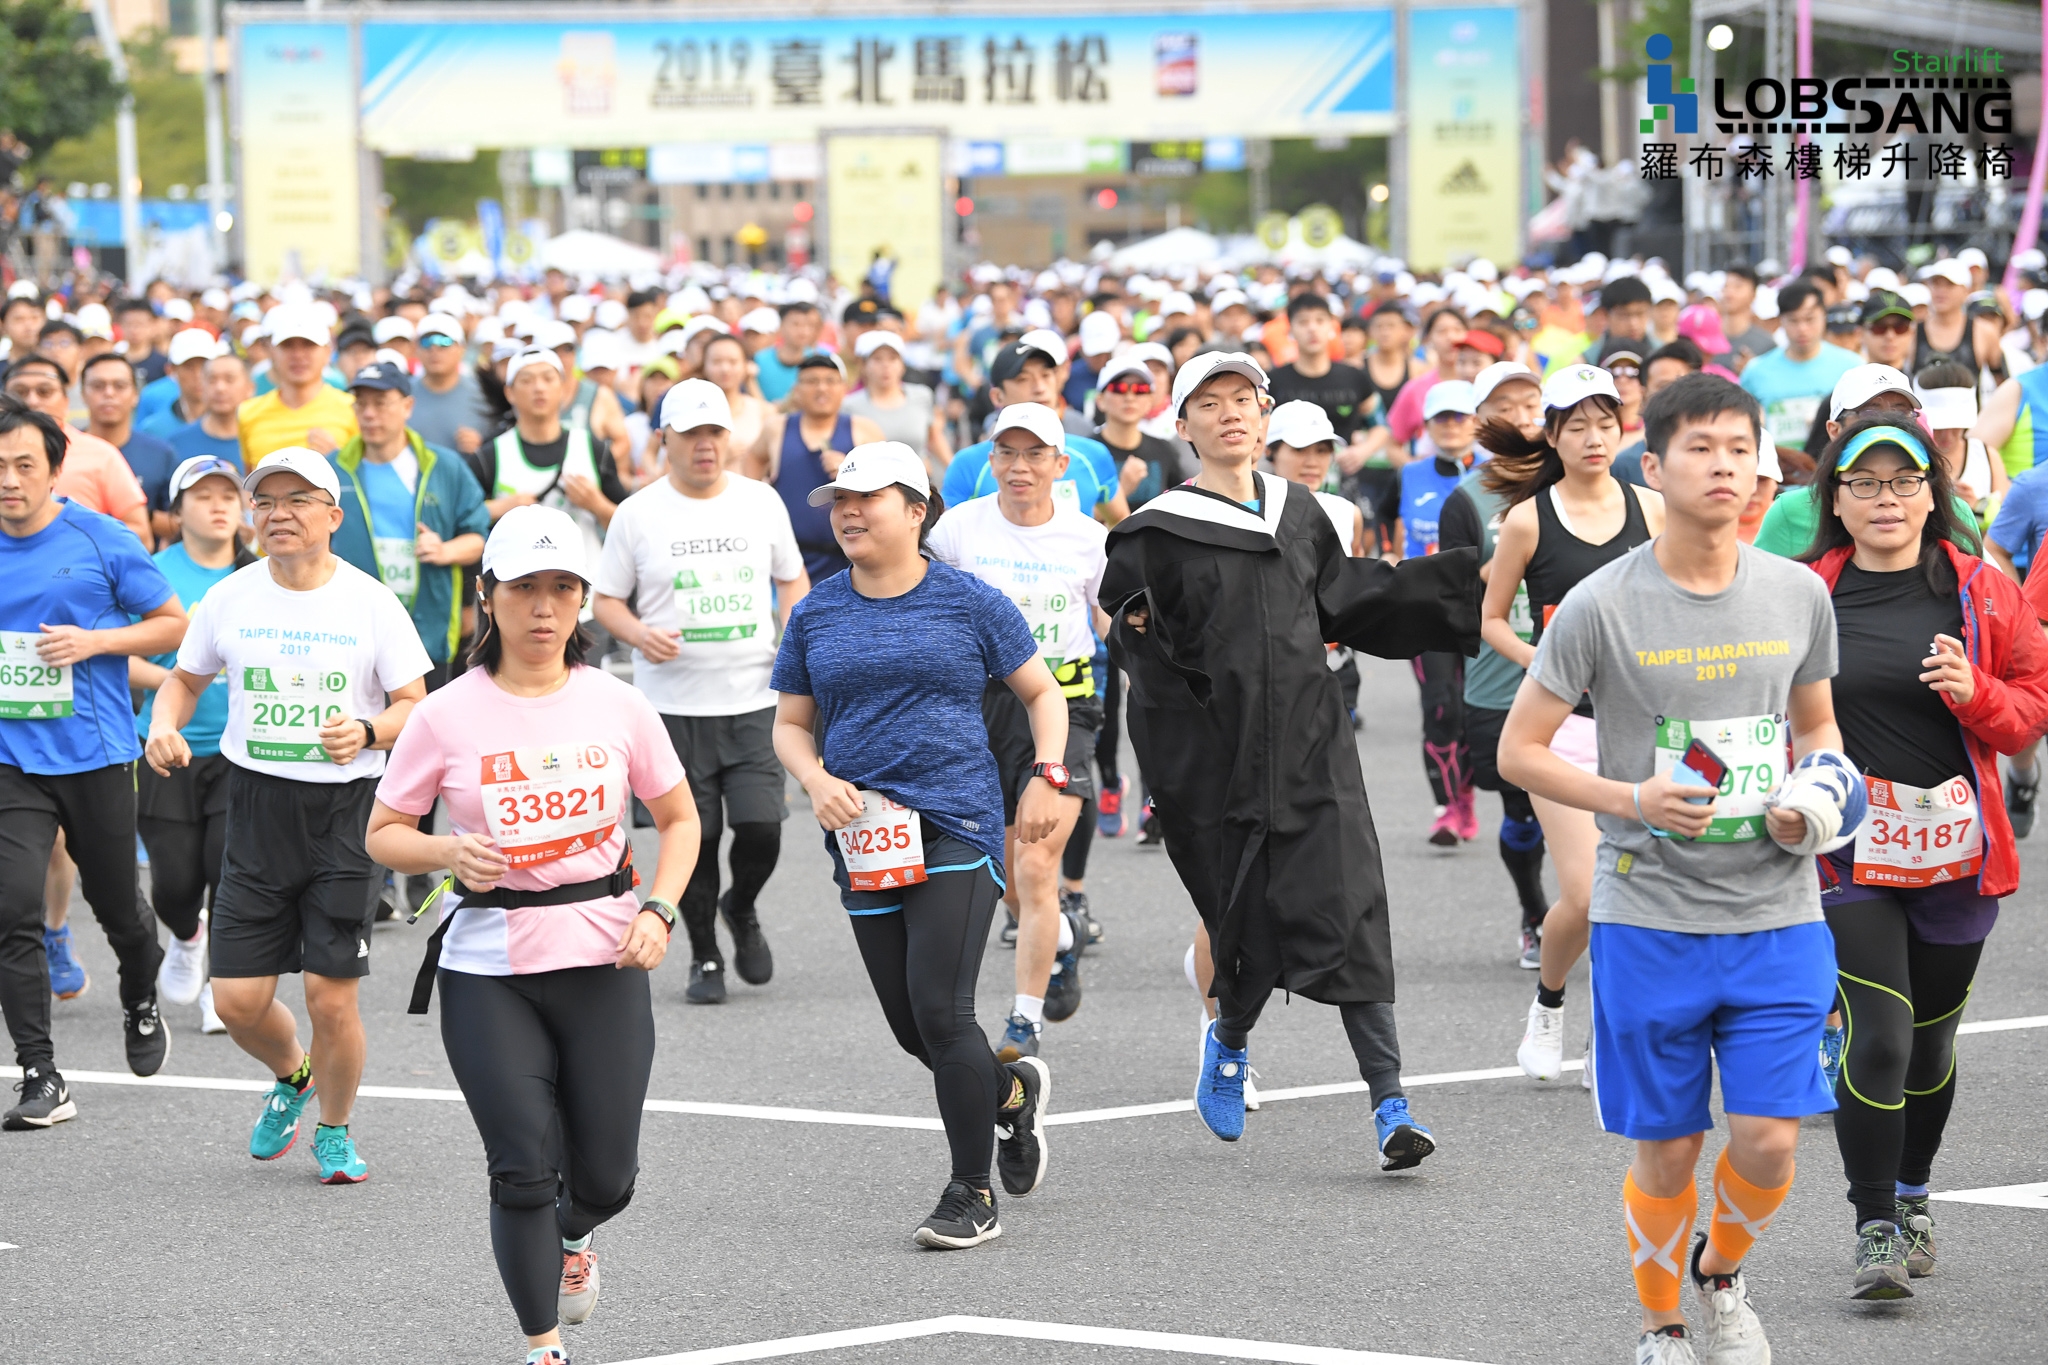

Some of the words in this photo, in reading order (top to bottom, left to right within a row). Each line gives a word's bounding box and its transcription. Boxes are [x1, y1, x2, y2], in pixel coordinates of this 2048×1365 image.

[653, 39, 752, 87] 2019
[771, 35, 1109, 104] 臺北馬拉松
[671, 537, 748, 556] SEIKO
[975, 556, 1011, 568] TAIPEI
[1014, 560, 1077, 575] MARATHON
[1012, 573, 1039, 583] 2019
[686, 593, 753, 615] 18052
[239, 628, 279, 640] TAIPEI
[282, 629, 357, 646] MARATHON
[280, 644, 311, 655] 2019
[1636, 648, 1692, 666] TAIPEI
[1697, 640, 1790, 662] MARATHON
[1696, 662, 1737, 681] 2019
[498, 784, 605, 826] 33821
[841, 823, 911, 856] 34235
[1870, 817, 1973, 852] 34187
[1911, 855, 1923, 864] 33
